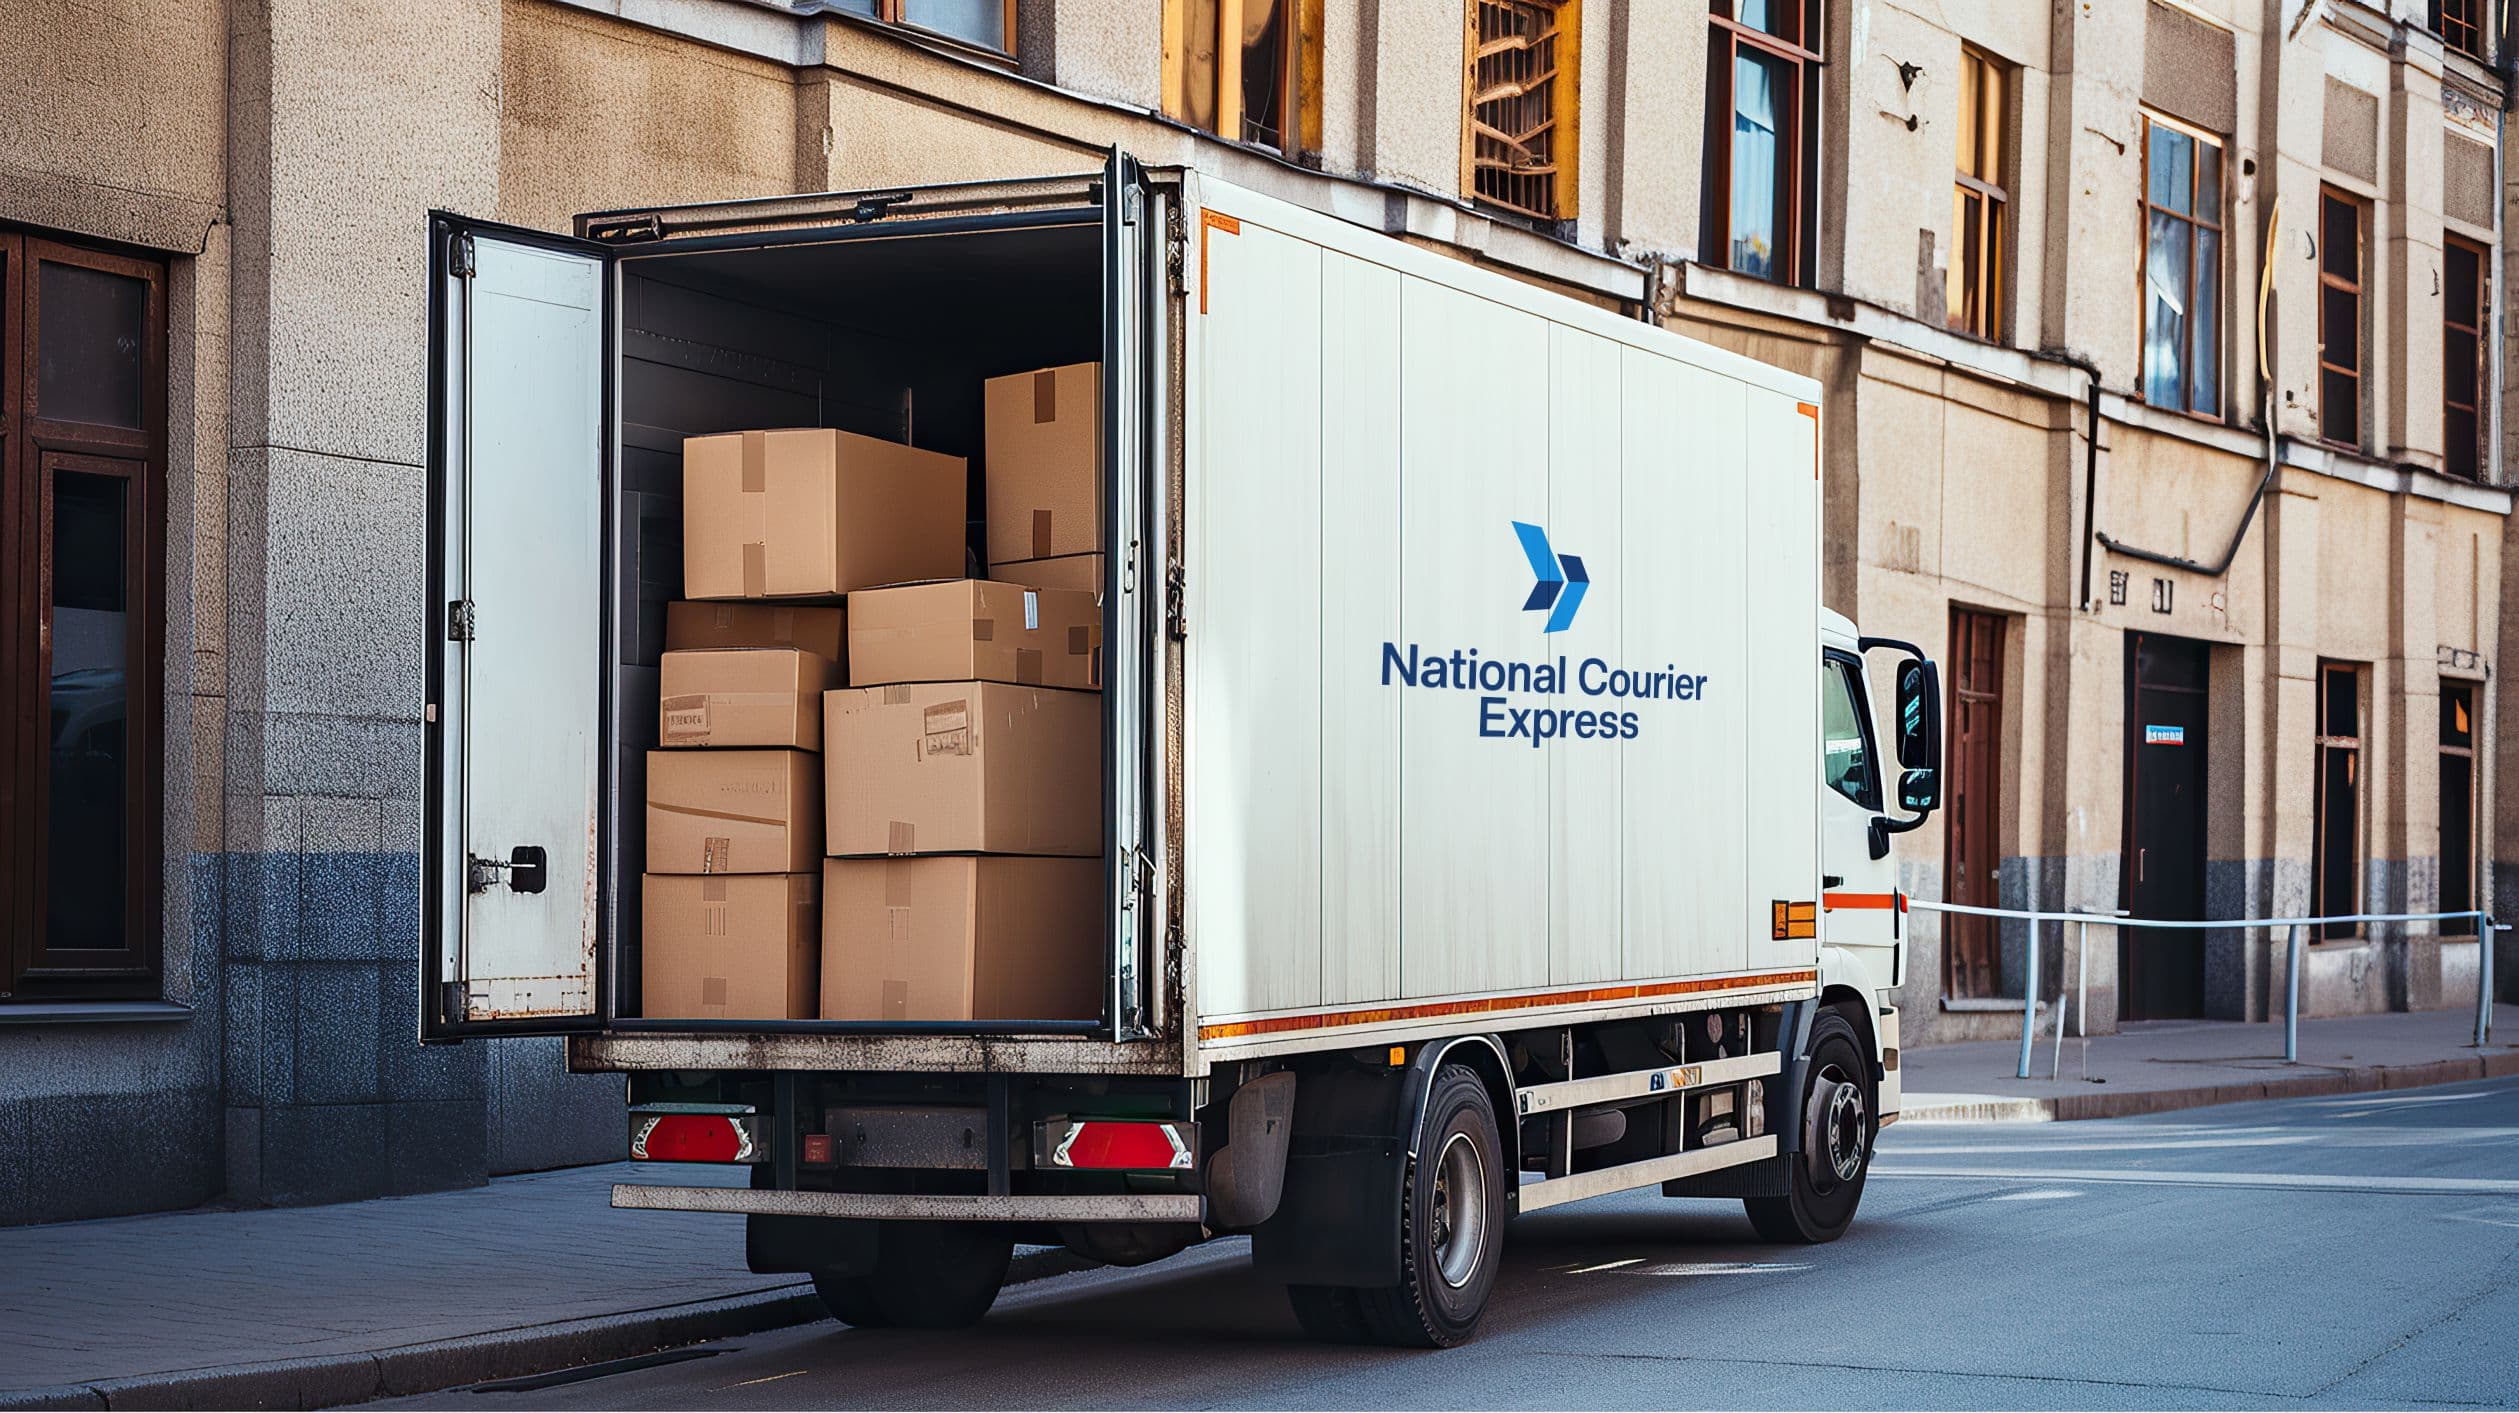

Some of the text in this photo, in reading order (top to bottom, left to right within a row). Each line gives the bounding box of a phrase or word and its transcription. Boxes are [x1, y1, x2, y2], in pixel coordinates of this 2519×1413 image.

[1381, 642, 1708, 700] National Courier
[1479, 696, 1639, 748] Express
